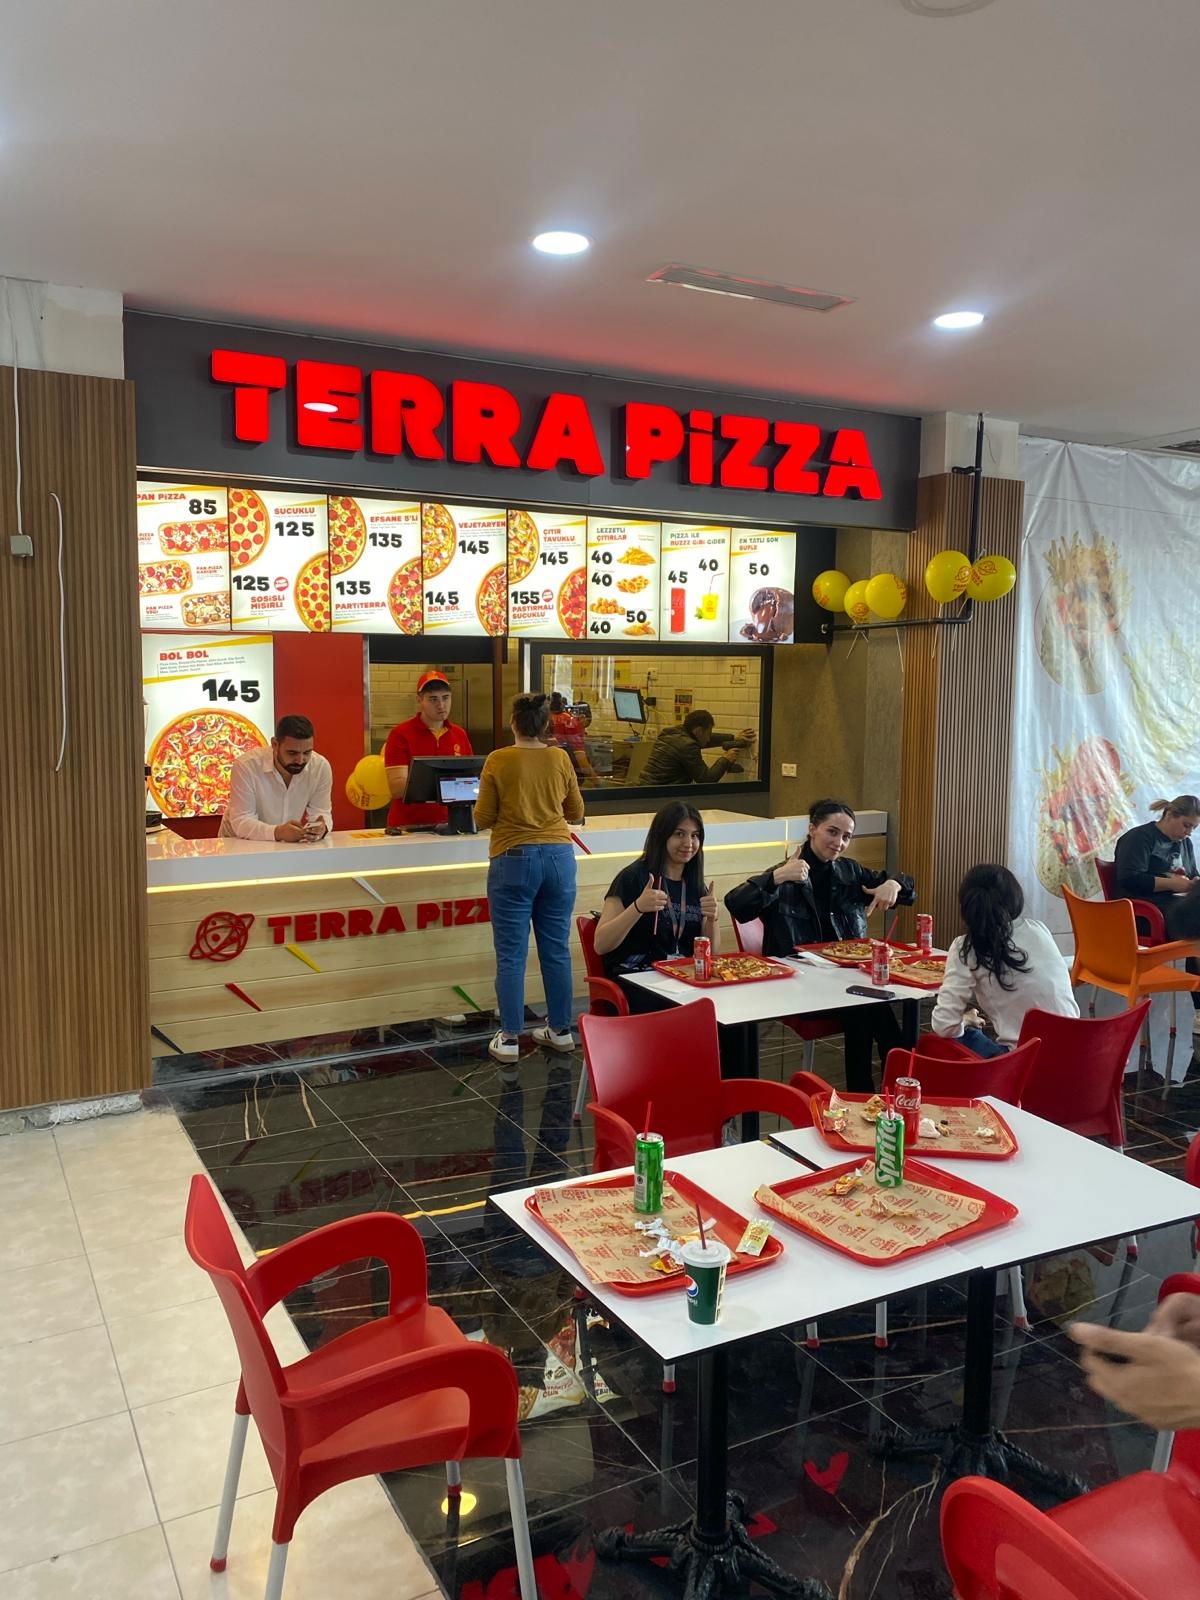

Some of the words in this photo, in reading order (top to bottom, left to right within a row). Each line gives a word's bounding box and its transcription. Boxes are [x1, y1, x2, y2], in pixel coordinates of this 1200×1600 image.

[210, 349, 604, 476] TERRA
[625, 401, 882, 500] PiZZA
[189, 499, 217, 515] 85
[273, 507, 315, 515] SUCUKLU
[275, 521, 315, 537] 125
[458, 521, 506, 529] VEJETARYEN
[368, 532, 402, 548] 135
[458, 540, 489, 554] 145
[539, 551, 569, 565] 145
[591, 550, 613, 565] 40
[698, 558, 719, 571] 40
[667, 570, 688, 583] 45
[748, 563, 769, 576] 50
[232, 575, 270, 591] 125
[591, 572, 613, 587] 40
[336, 581, 371, 596] 135
[250, 594, 285, 603] SOSiSLi
[425, 591, 459, 605] 145
[511, 591, 540, 605] 155
[250, 601, 283, 610] MISIRLI
[335, 601, 387, 610] PARTiTERRA
[512, 604, 554, 612] PASTIRMALI
[512, 611, 546, 619] SUCUKLU
[626, 610, 647, 623] 50
[590, 621, 611, 634] 40
[159, 652, 182, 661] BOL
[186, 650, 209, 659] BOL
[202, 678, 261, 703] 145
[267, 906, 406, 945] TERRA
[416, 897, 489, 930] PiZZ
[874, 1118, 901, 1188] Sprite
